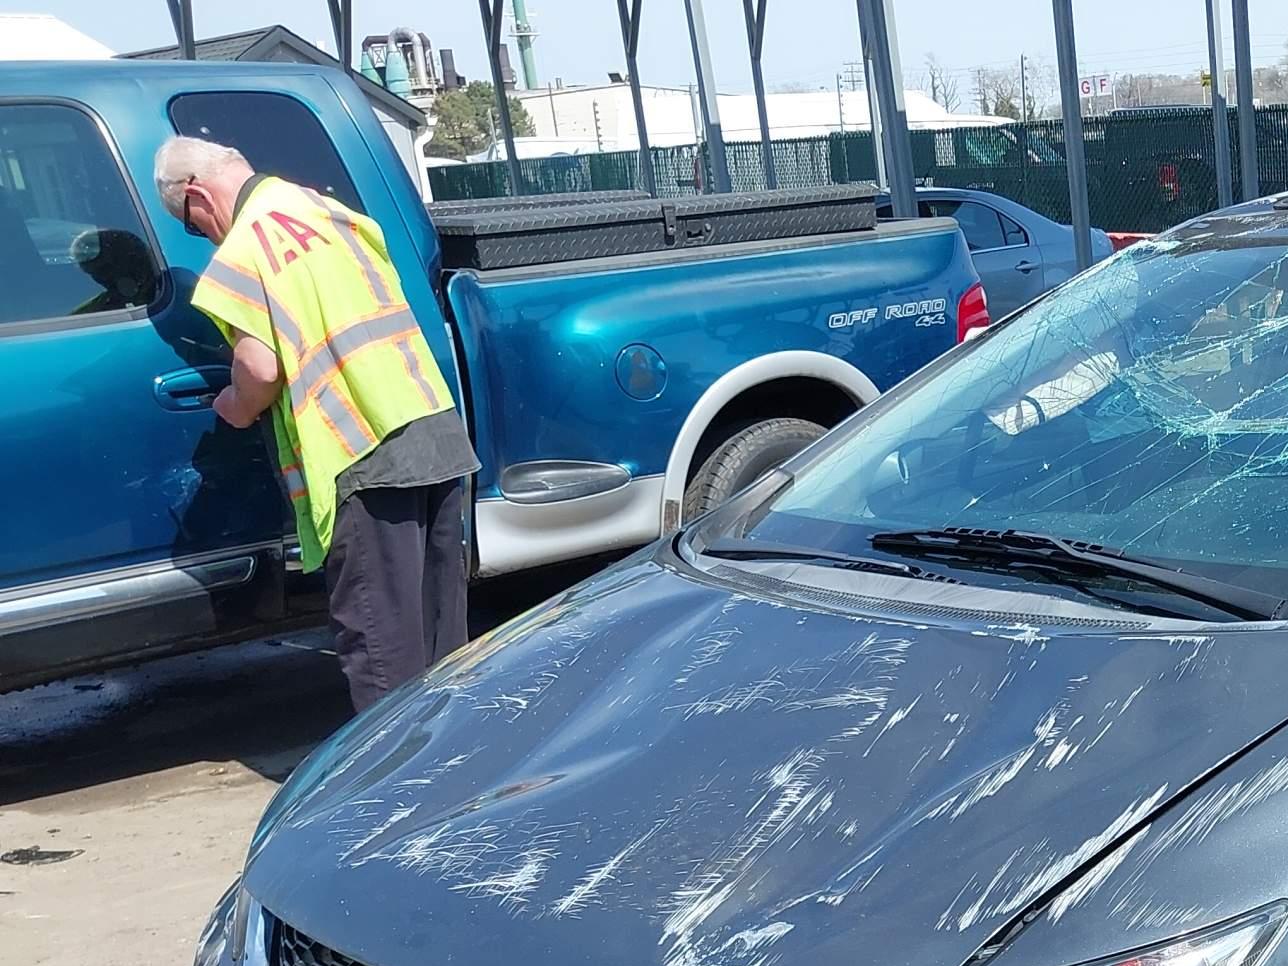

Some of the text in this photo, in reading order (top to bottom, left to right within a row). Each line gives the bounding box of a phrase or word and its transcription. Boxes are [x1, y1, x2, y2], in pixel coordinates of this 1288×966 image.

[1081, 78, 1107, 95] G F
[828, 298, 946, 329] OFF ROAD
